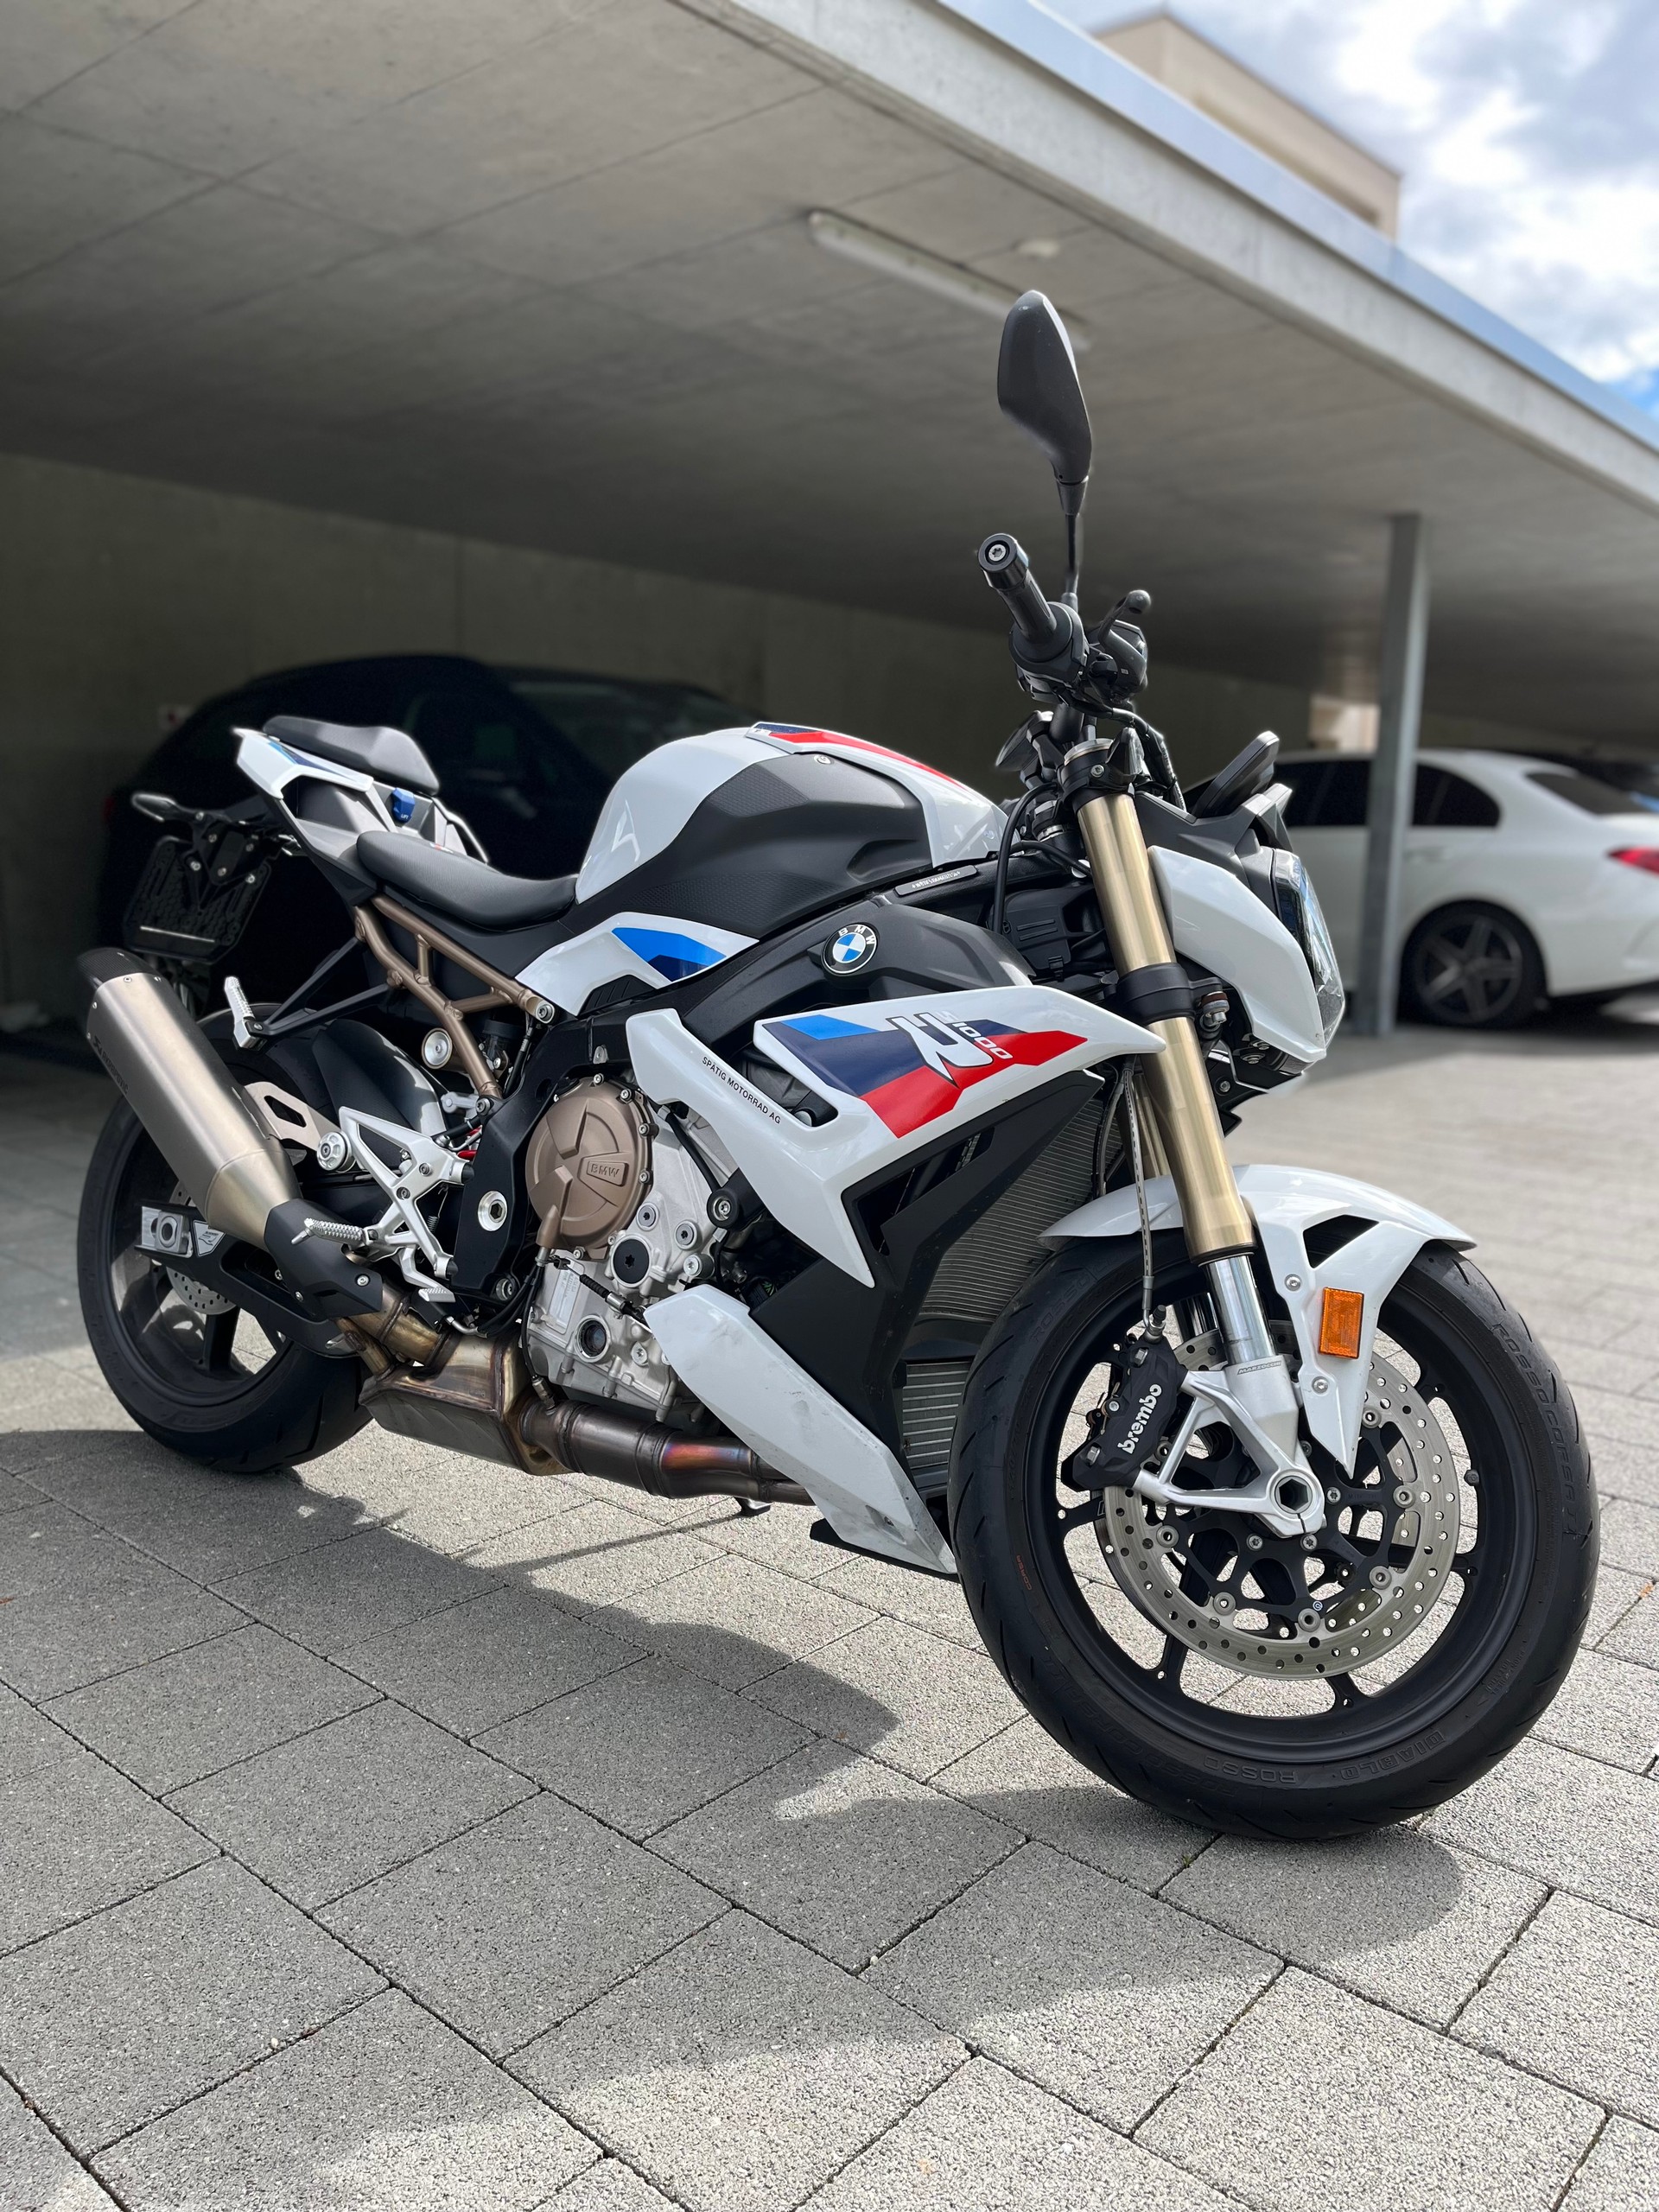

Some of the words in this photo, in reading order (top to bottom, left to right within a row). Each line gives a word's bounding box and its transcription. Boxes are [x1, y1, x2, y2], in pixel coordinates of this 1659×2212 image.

[838, 925, 876, 945] BMW
[727, 1077, 769, 1114] MOTORRAD
[768, 1111, 782, 1125] AG
[590, 1163, 620, 1178] BMW
[1116, 1383, 1162, 1454] brembo
[1492, 1322, 1550, 1406] ROSSO
[1543, 1408, 1578, 1503] CORSA
[1203, 1754, 1297, 1784] ROSSO
[1340, 1730, 1446, 1782] DIABLO
